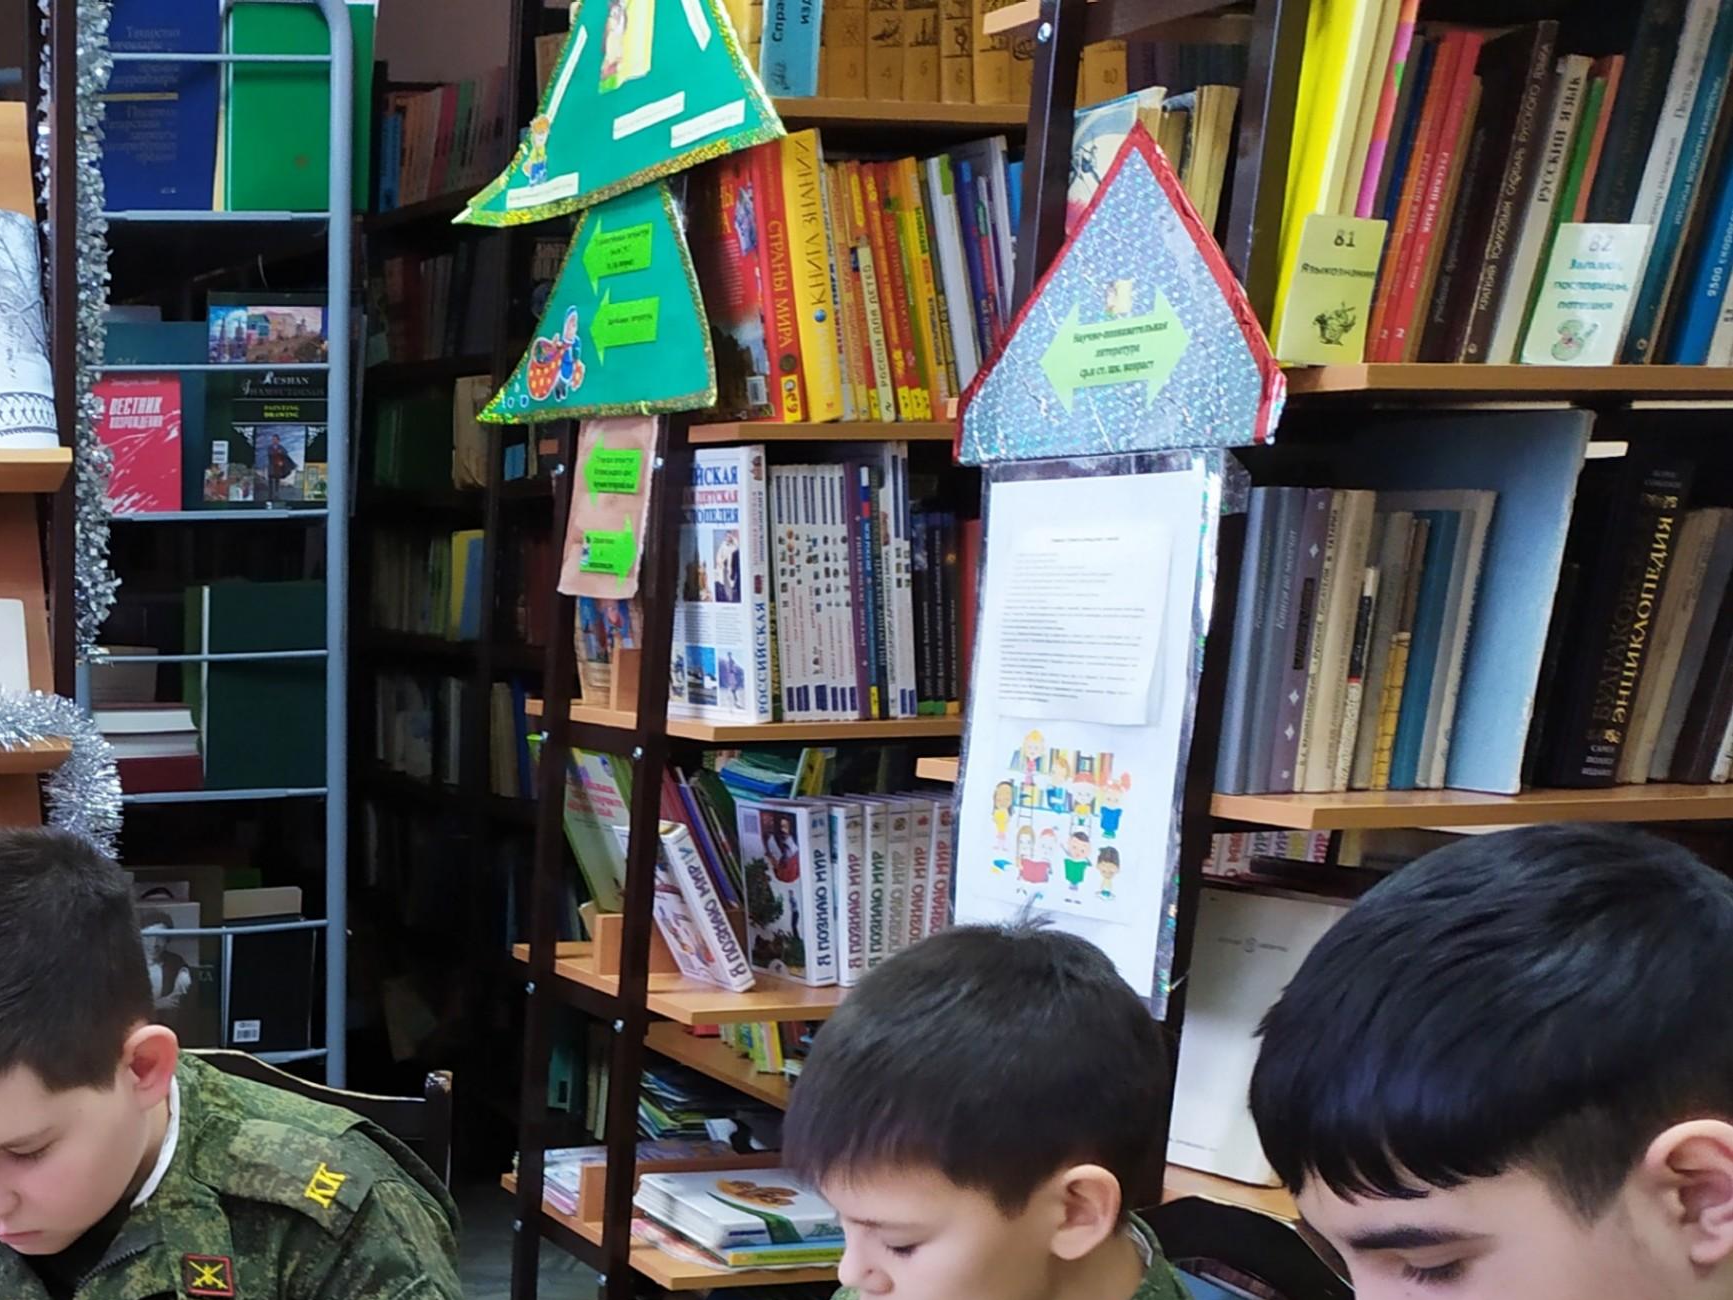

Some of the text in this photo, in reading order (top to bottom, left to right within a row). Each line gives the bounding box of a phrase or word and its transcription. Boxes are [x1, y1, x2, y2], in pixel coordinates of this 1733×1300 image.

[1535, 74, 1583, 204] РУССКИЙ ЯЗЫК
[1335, 230, 1356, 248] 81
[1301, 261, 1375, 279] Языкознание
[776, 298, 793, 349] МИРА
[1612, 515, 1675, 724] ЭНЦИКЛОПЕДИЯ
[757, 601, 769, 716] РОССИЙСКАЯ
[871, 850, 884, 884] МИР
[891, 850, 906, 884] МИР
[912, 846, 927, 880] МИР
[937, 840, 951, 876] МИР
[688, 863, 748, 979] Я ПОЗНАЮ МИР
[813, 848, 831, 967] Я ПОЗНАЮ МИР
[848, 853, 863, 969] Я ПОЗНАЮ МИР
[869, 886, 884, 955] ПОЗНАЮ
[304, 1162, 346, 1209] КК
